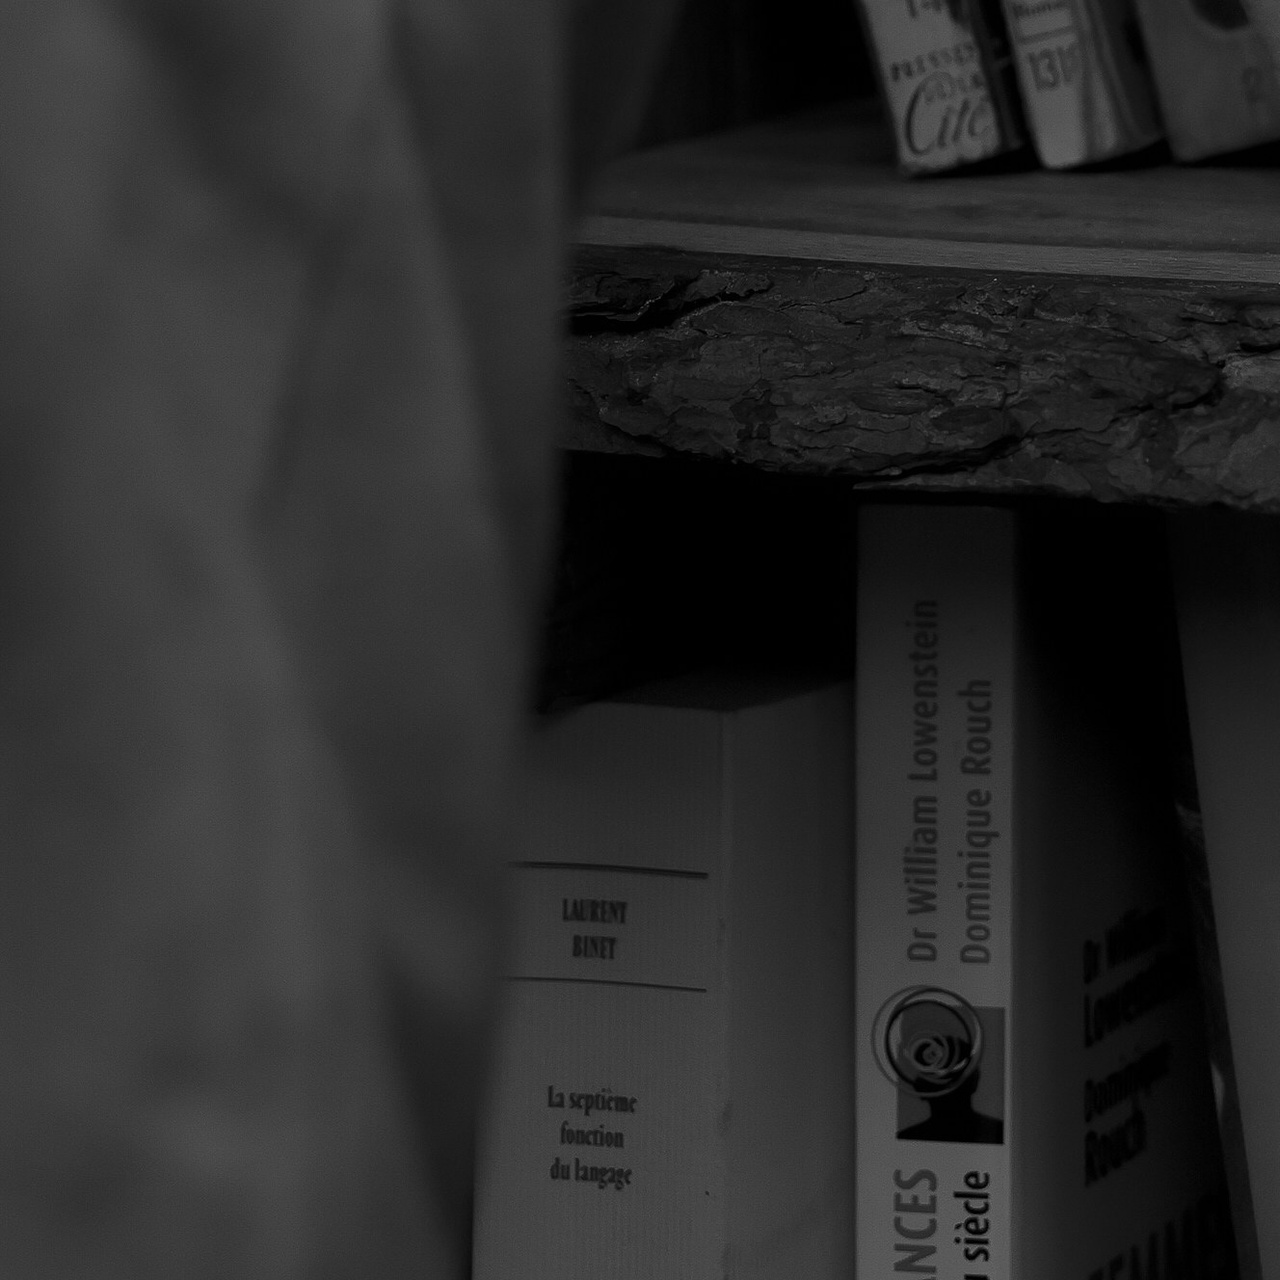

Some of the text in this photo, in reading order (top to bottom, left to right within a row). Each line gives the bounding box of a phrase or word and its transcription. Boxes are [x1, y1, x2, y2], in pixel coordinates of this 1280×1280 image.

[902, 599, 938, 962] Dr William Lowenstein
[956, 679, 1000, 965] Dominique Rouch
[562, 898, 628, 925] LAURENT
[572, 934, 617, 960] BINET
[548, 1085, 638, 1117] La septième
[559, 1120, 625, 1148] fonction
[550, 1157, 633, 1191] du langage
[892, 1167, 939, 1280] NCES
[954, 1170, 991, 1262] siècle
